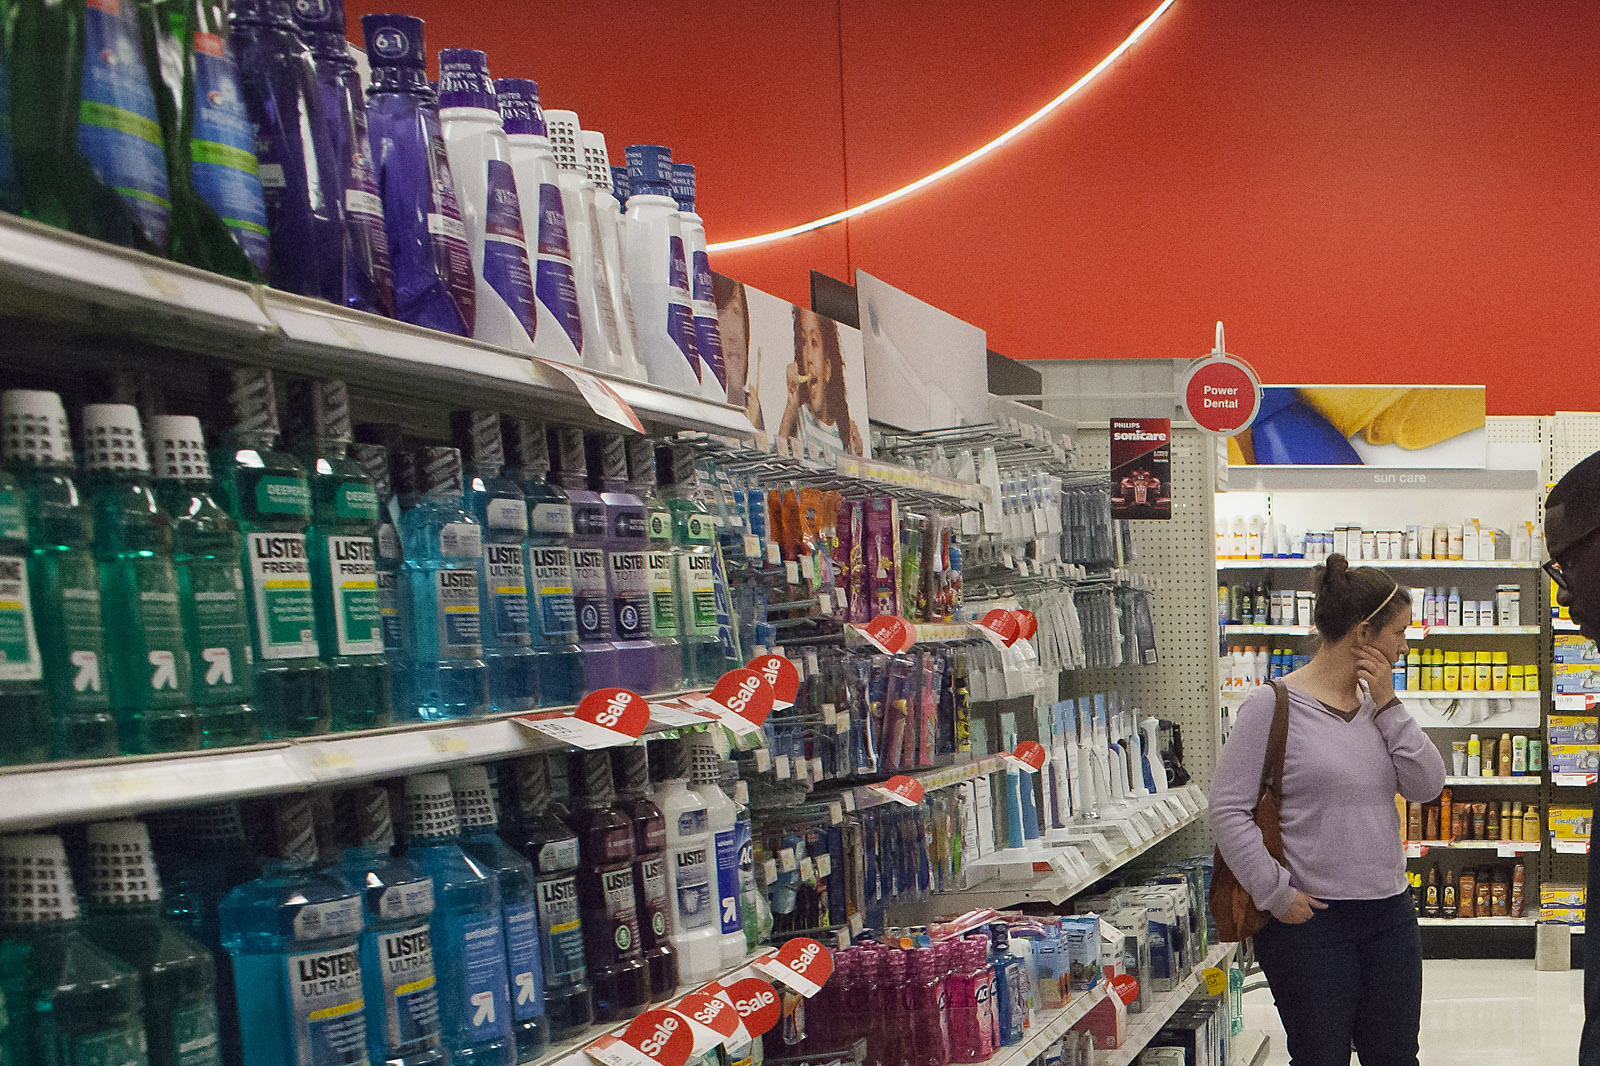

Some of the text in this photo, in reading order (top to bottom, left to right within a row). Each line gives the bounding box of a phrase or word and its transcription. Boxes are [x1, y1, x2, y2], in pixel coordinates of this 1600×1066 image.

[1203, 385, 1238, 397] Power
[1203, 398, 1239, 409] Dental
[1113, 430, 1167, 442] sonicare
[1373, 473, 1426, 484] sun care
[256, 537, 307, 559] LISTE
[763, 658, 781, 685] ale
[726, 674, 760, 713] Sale
[596, 692, 633, 727] Sale
[790, 941, 820, 974] Sale
[693, 997, 725, 1026] Sale
[735, 988, 775, 1018] Sale
[641, 1014, 679, 1058] Sale
